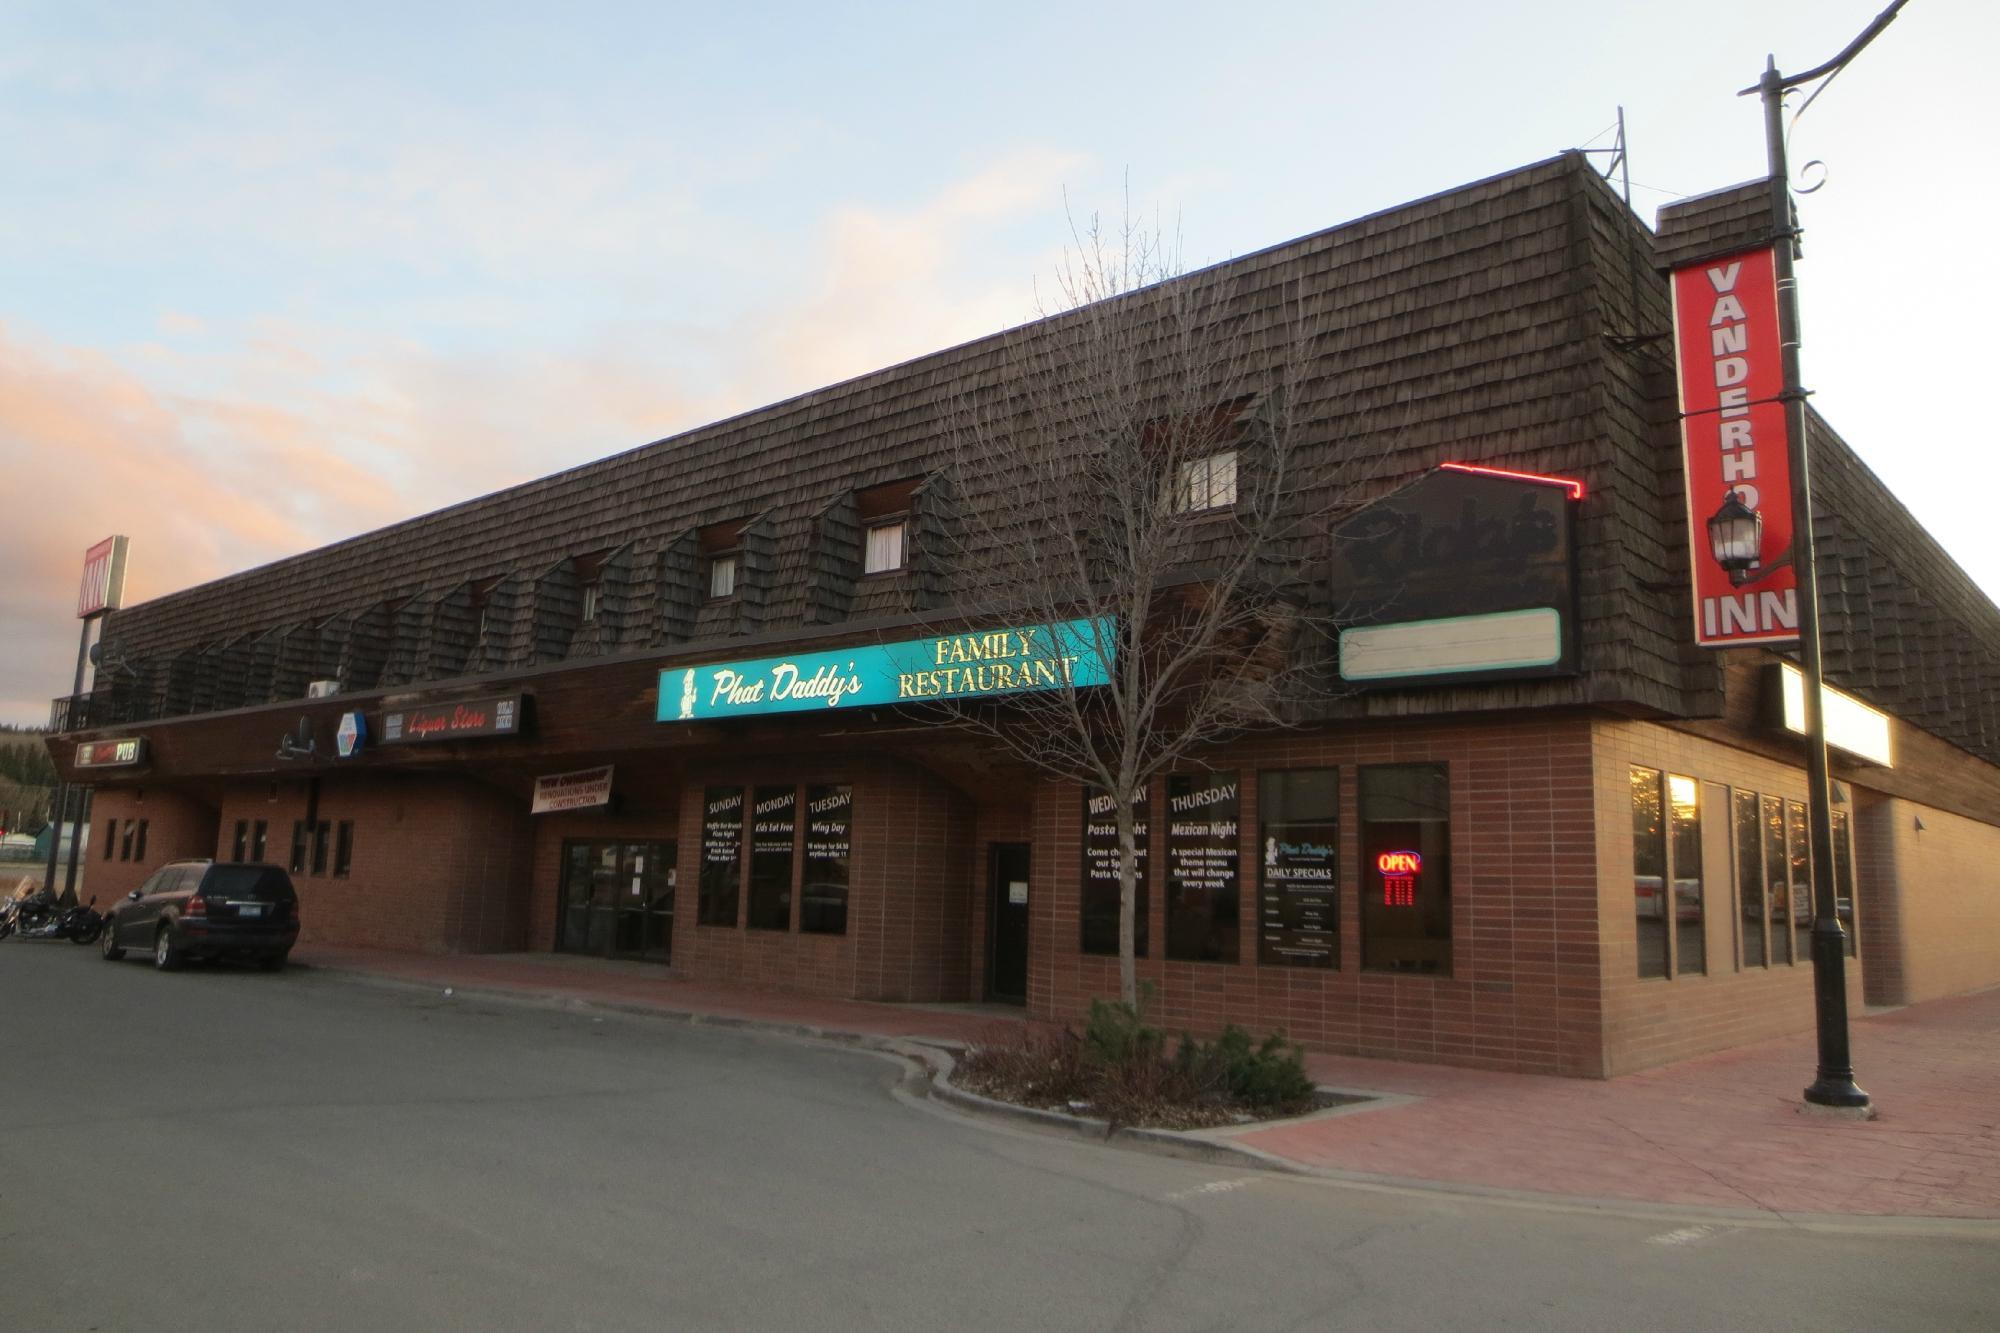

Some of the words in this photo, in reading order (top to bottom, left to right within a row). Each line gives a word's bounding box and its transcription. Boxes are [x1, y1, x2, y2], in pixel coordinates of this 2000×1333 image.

[1705, 261, 1761, 570] VANDERHO
[1704, 588, 1799, 637] INN
[935, 629, 1037, 666] FAMILY
[710, 669, 764, 707] Phat
[770, 661, 864, 708] Daddy's
[898, 656, 1079, 698] RESTAURANT
[408, 711, 447, 739] Liquor
[451, 703, 486, 730] Store
[115, 742, 135, 761] PUB
[539, 786, 584, 801] RENOVATIONS
[584, 782, 608, 794] UNDER
[1088, 785, 1147, 815] WEDNAY
[1171, 783, 1237, 814] THURSDAY
[549, 795, 597, 809] CONSTRUCTION
[709, 794, 742, 814] SUNDAY
[756, 793, 795, 815] MONDAY
[809, 792, 851, 814] TUESDAY
[755, 822, 768, 832] Kids
[769, 822, 779, 832] Eat
[779, 822, 794, 832] Free
[812, 821, 830, 835] Wing
[831, 822, 846, 835] Day
[1087, 824, 1116, 836] Pasta
[1171, 823, 1209, 836] Mexican
[1210, 821, 1237, 840] Night
[1087, 848, 1109, 857] Come
[1171, 848, 1178, 856] A
[1205, 848, 1238, 857] Mexican
[1096, 860, 1109, 868] our
[1180, 858, 1204, 867] theme
[1206, 859, 1228, 867] menu
[1379, 854, 1418, 872] OPEN
[1090, 869, 1112, 879] Pasta
[1174, 868, 1190, 877] that
[1191, 868, 1205, 877] will
[1206, 868, 1234, 880] change
[1267, 868, 1291, 878] DAILY
[1292, 868, 1332, 878] SPECIALS
[1182, 880, 1203, 889] every
[1204, 879, 1225, 888] week
